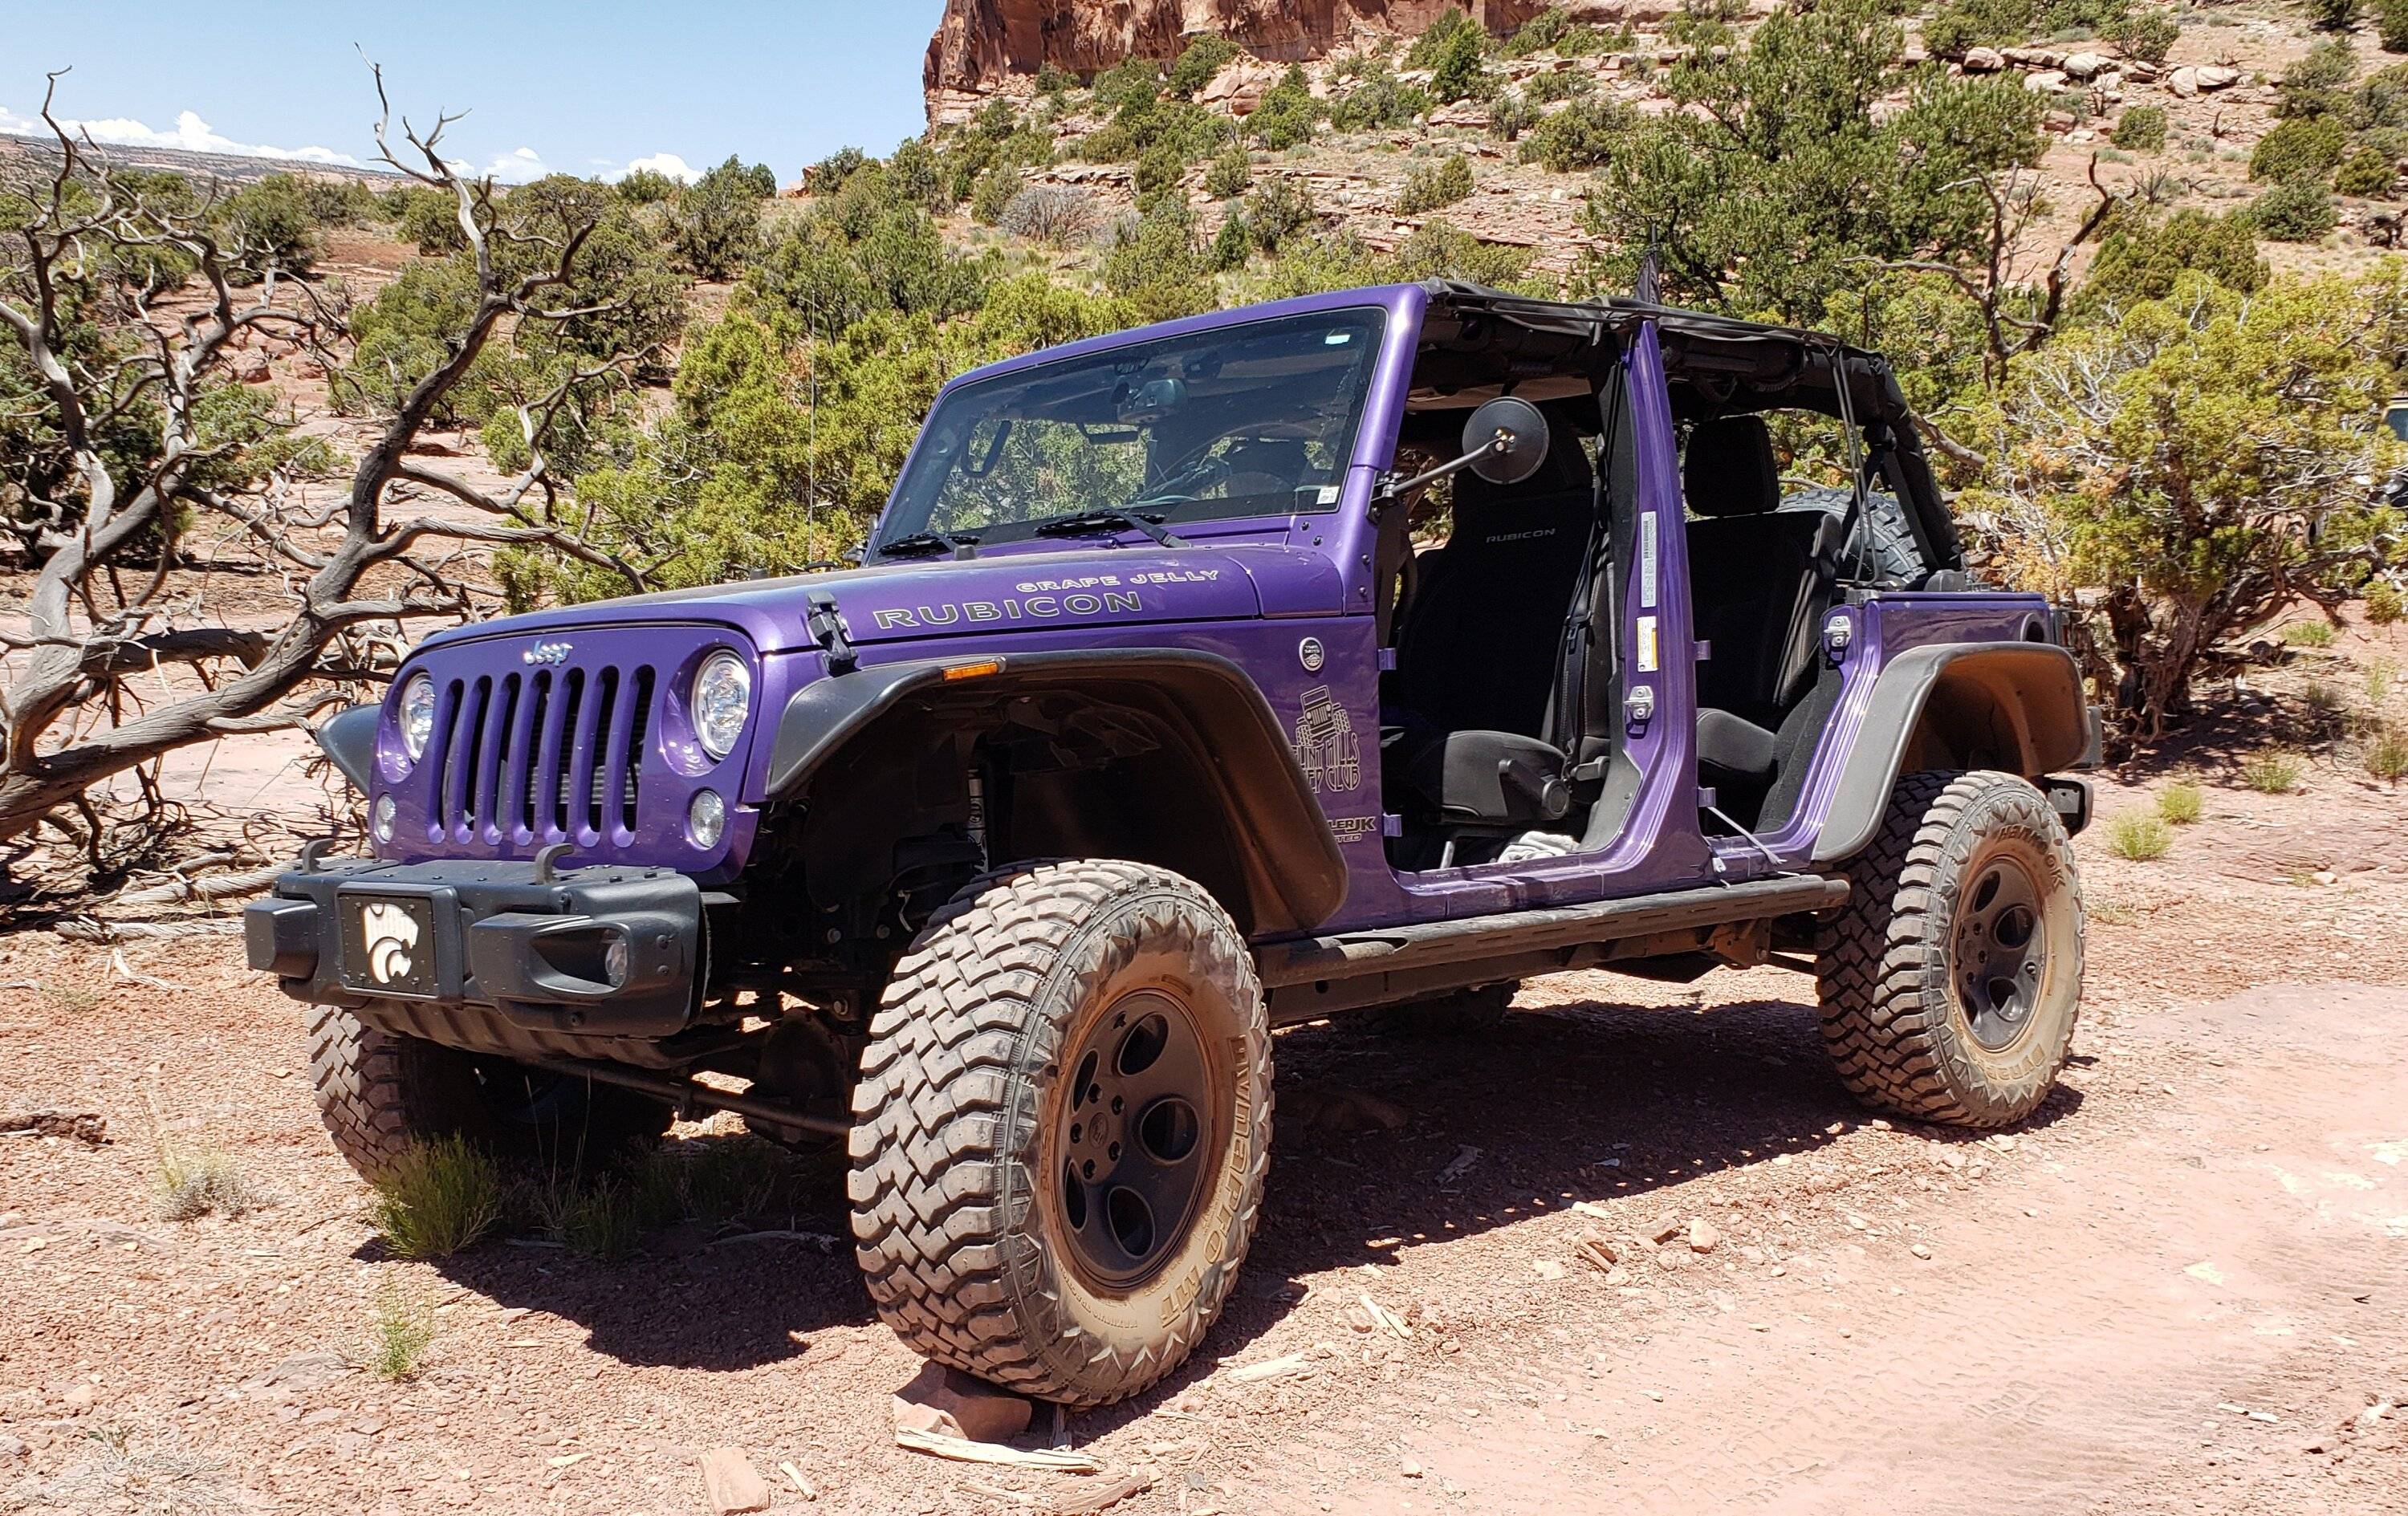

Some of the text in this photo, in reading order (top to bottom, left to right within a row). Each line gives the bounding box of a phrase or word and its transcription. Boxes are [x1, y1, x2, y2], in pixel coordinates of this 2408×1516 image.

[1485, 528, 1556, 543] RUBICON
[1016, 571, 1219, 592] GRAPE JELLY
[873, 591, 1143, 629] RUBICON
[1325, 764, 1361, 792] CLUB
